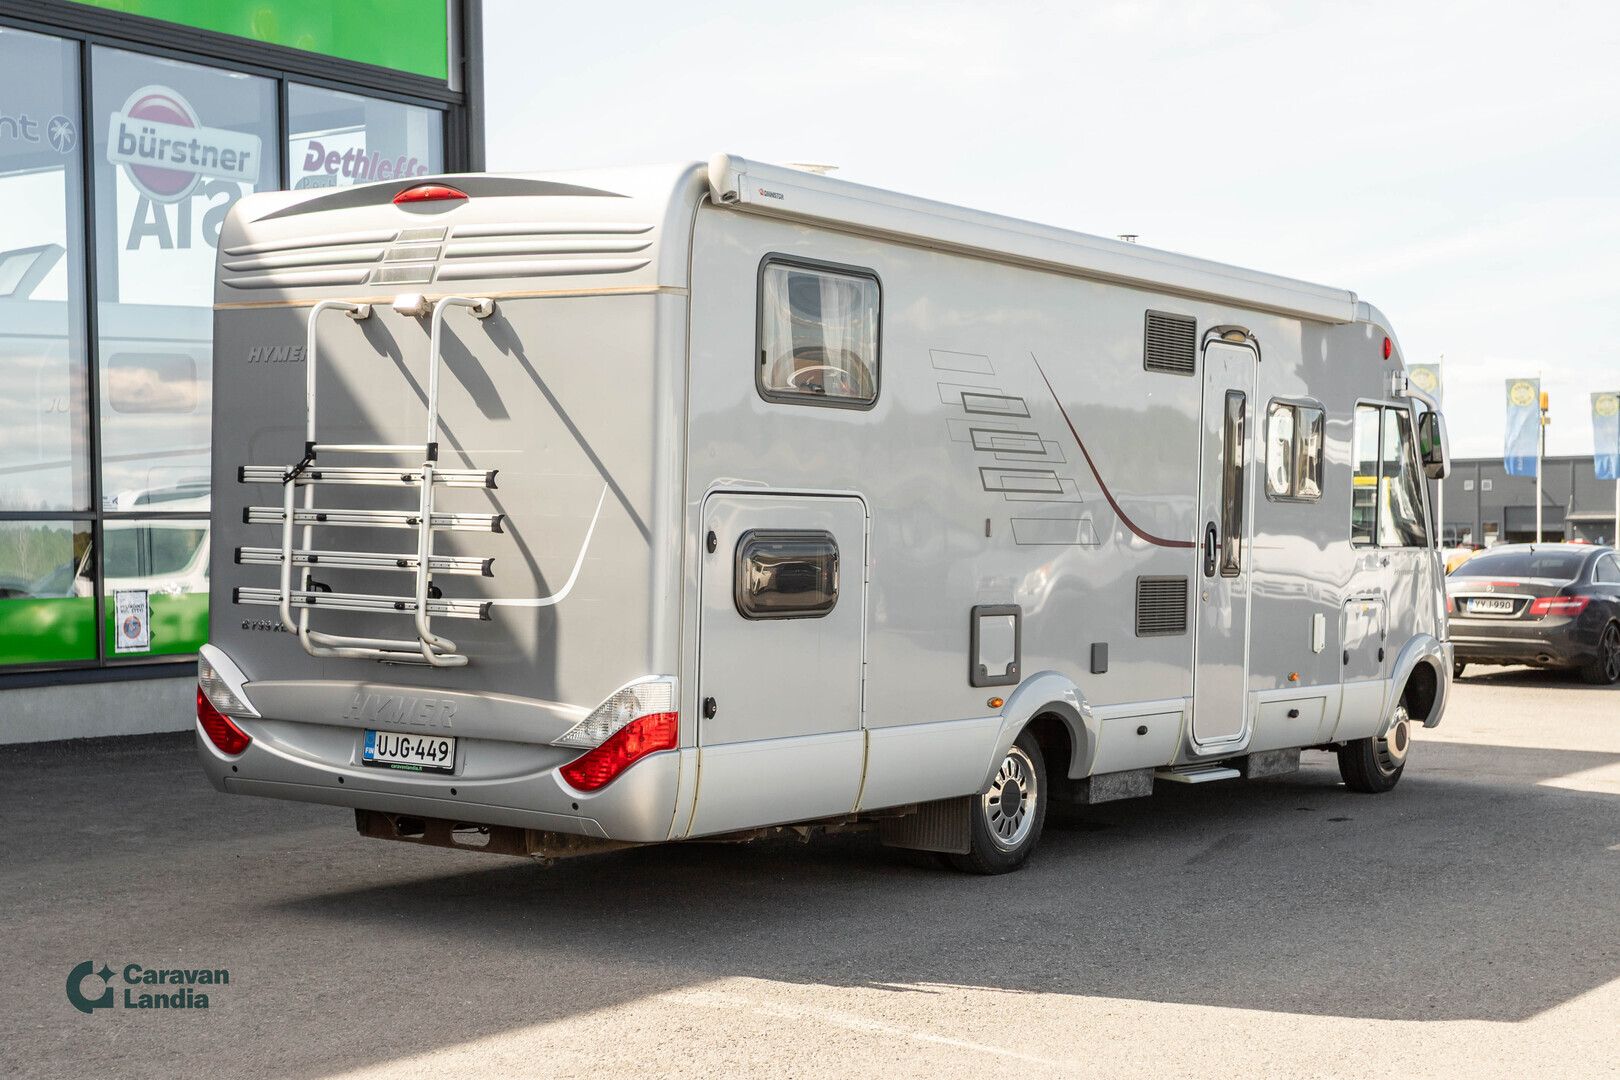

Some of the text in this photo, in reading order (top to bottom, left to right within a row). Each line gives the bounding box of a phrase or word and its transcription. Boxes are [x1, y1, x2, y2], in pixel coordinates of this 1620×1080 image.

[117, 123, 250, 172] bürstner
[343, 692, 457, 729] HYMER
[378, 735, 449, 762] UJG-449
